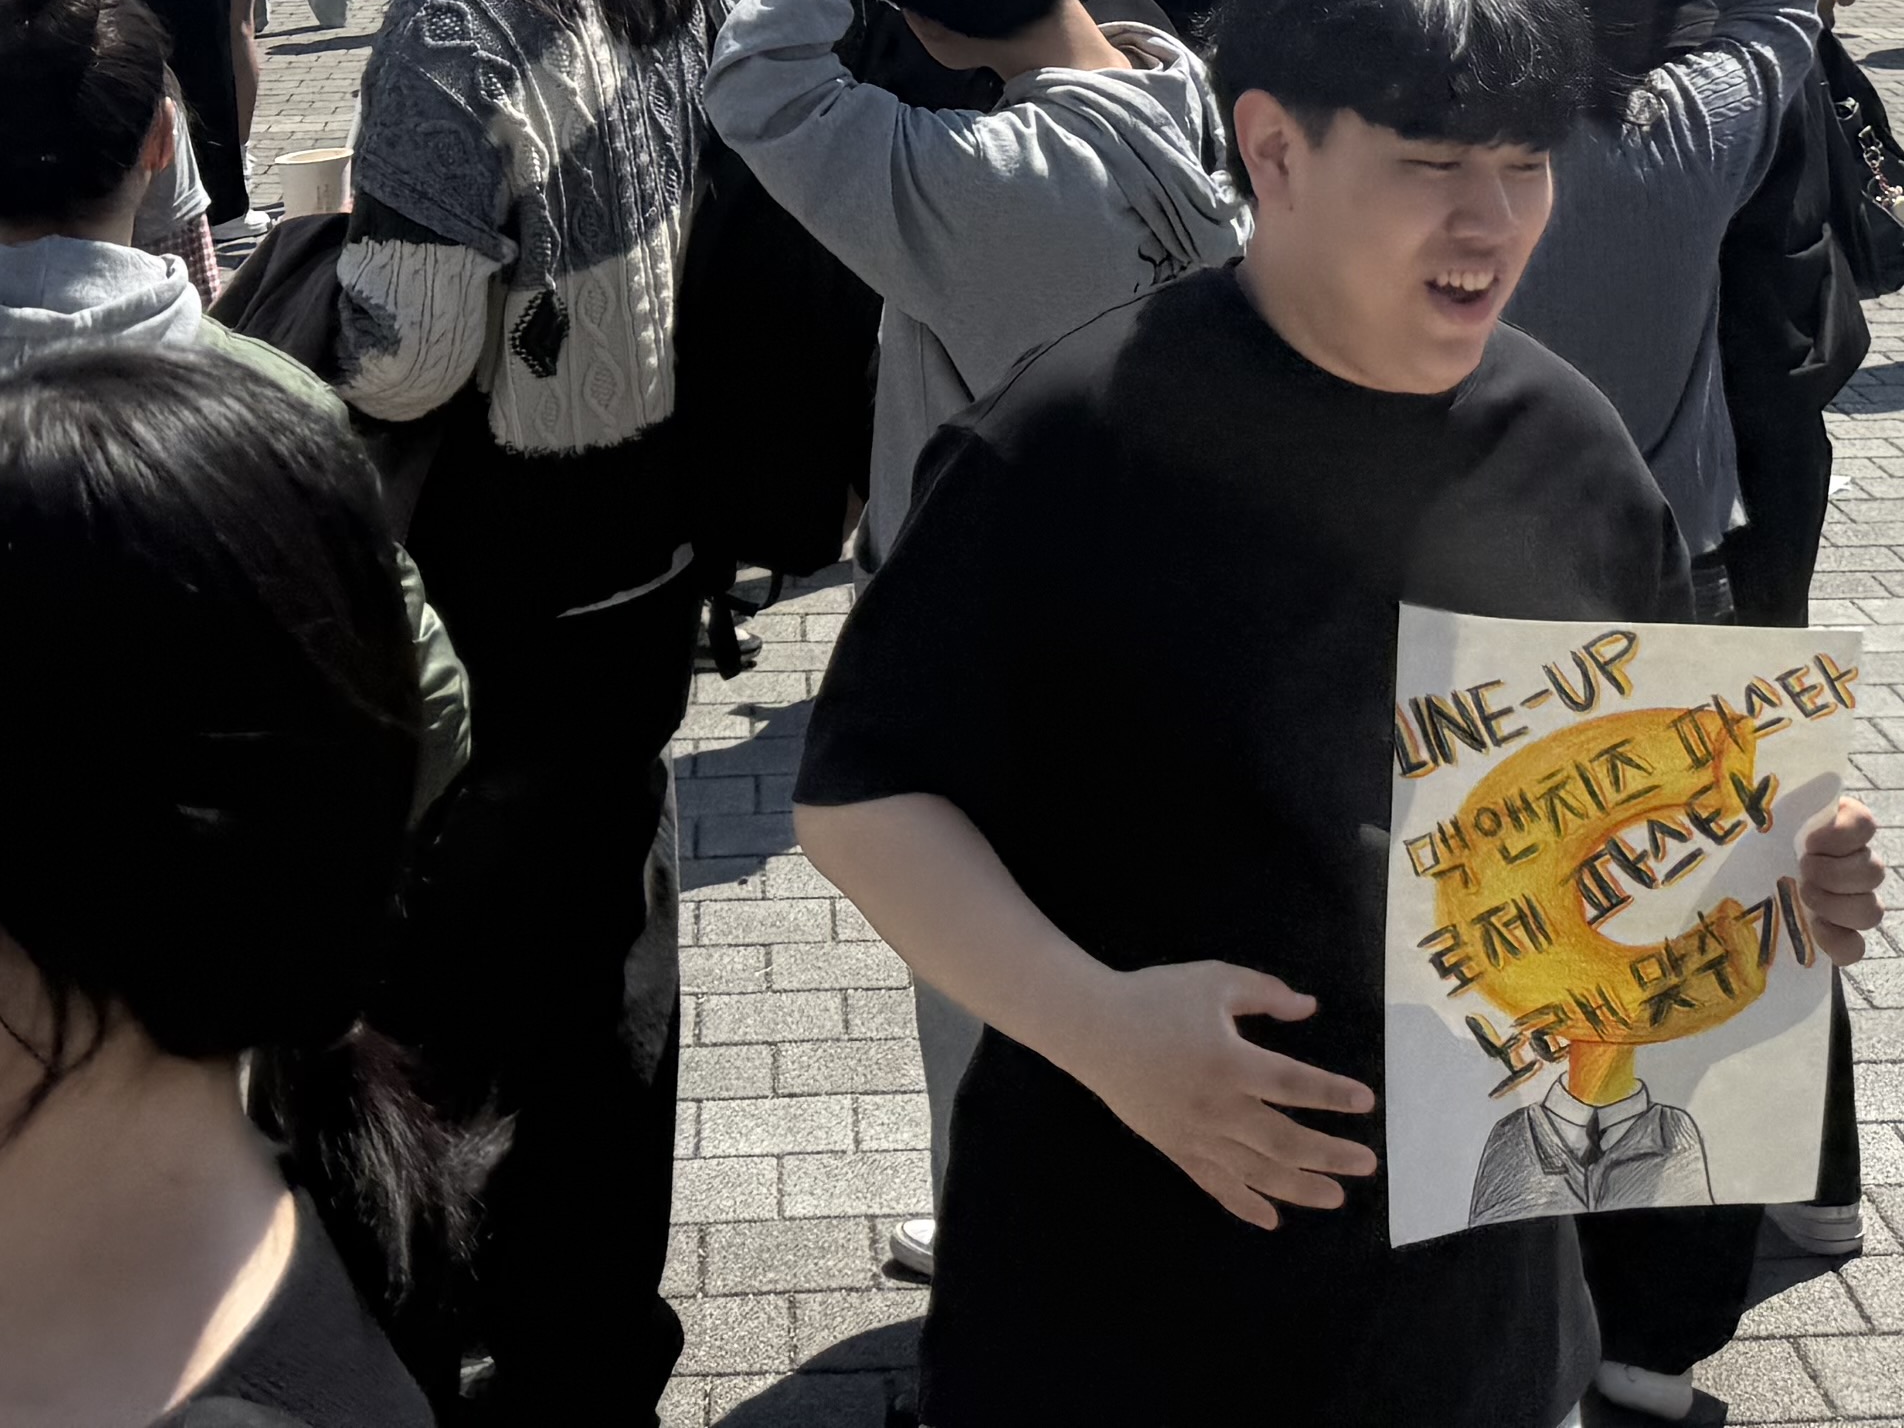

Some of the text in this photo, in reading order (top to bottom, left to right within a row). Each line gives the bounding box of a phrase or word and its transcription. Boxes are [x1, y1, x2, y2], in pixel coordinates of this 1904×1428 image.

[1395, 629, 1641, 778] LINE-UP
[1402, 652, 1859, 891] 맥앤치즈 파스타
[1417, 773, 1780, 998] 로제 파스타
[1464, 987, 1633, 1100] 노래
